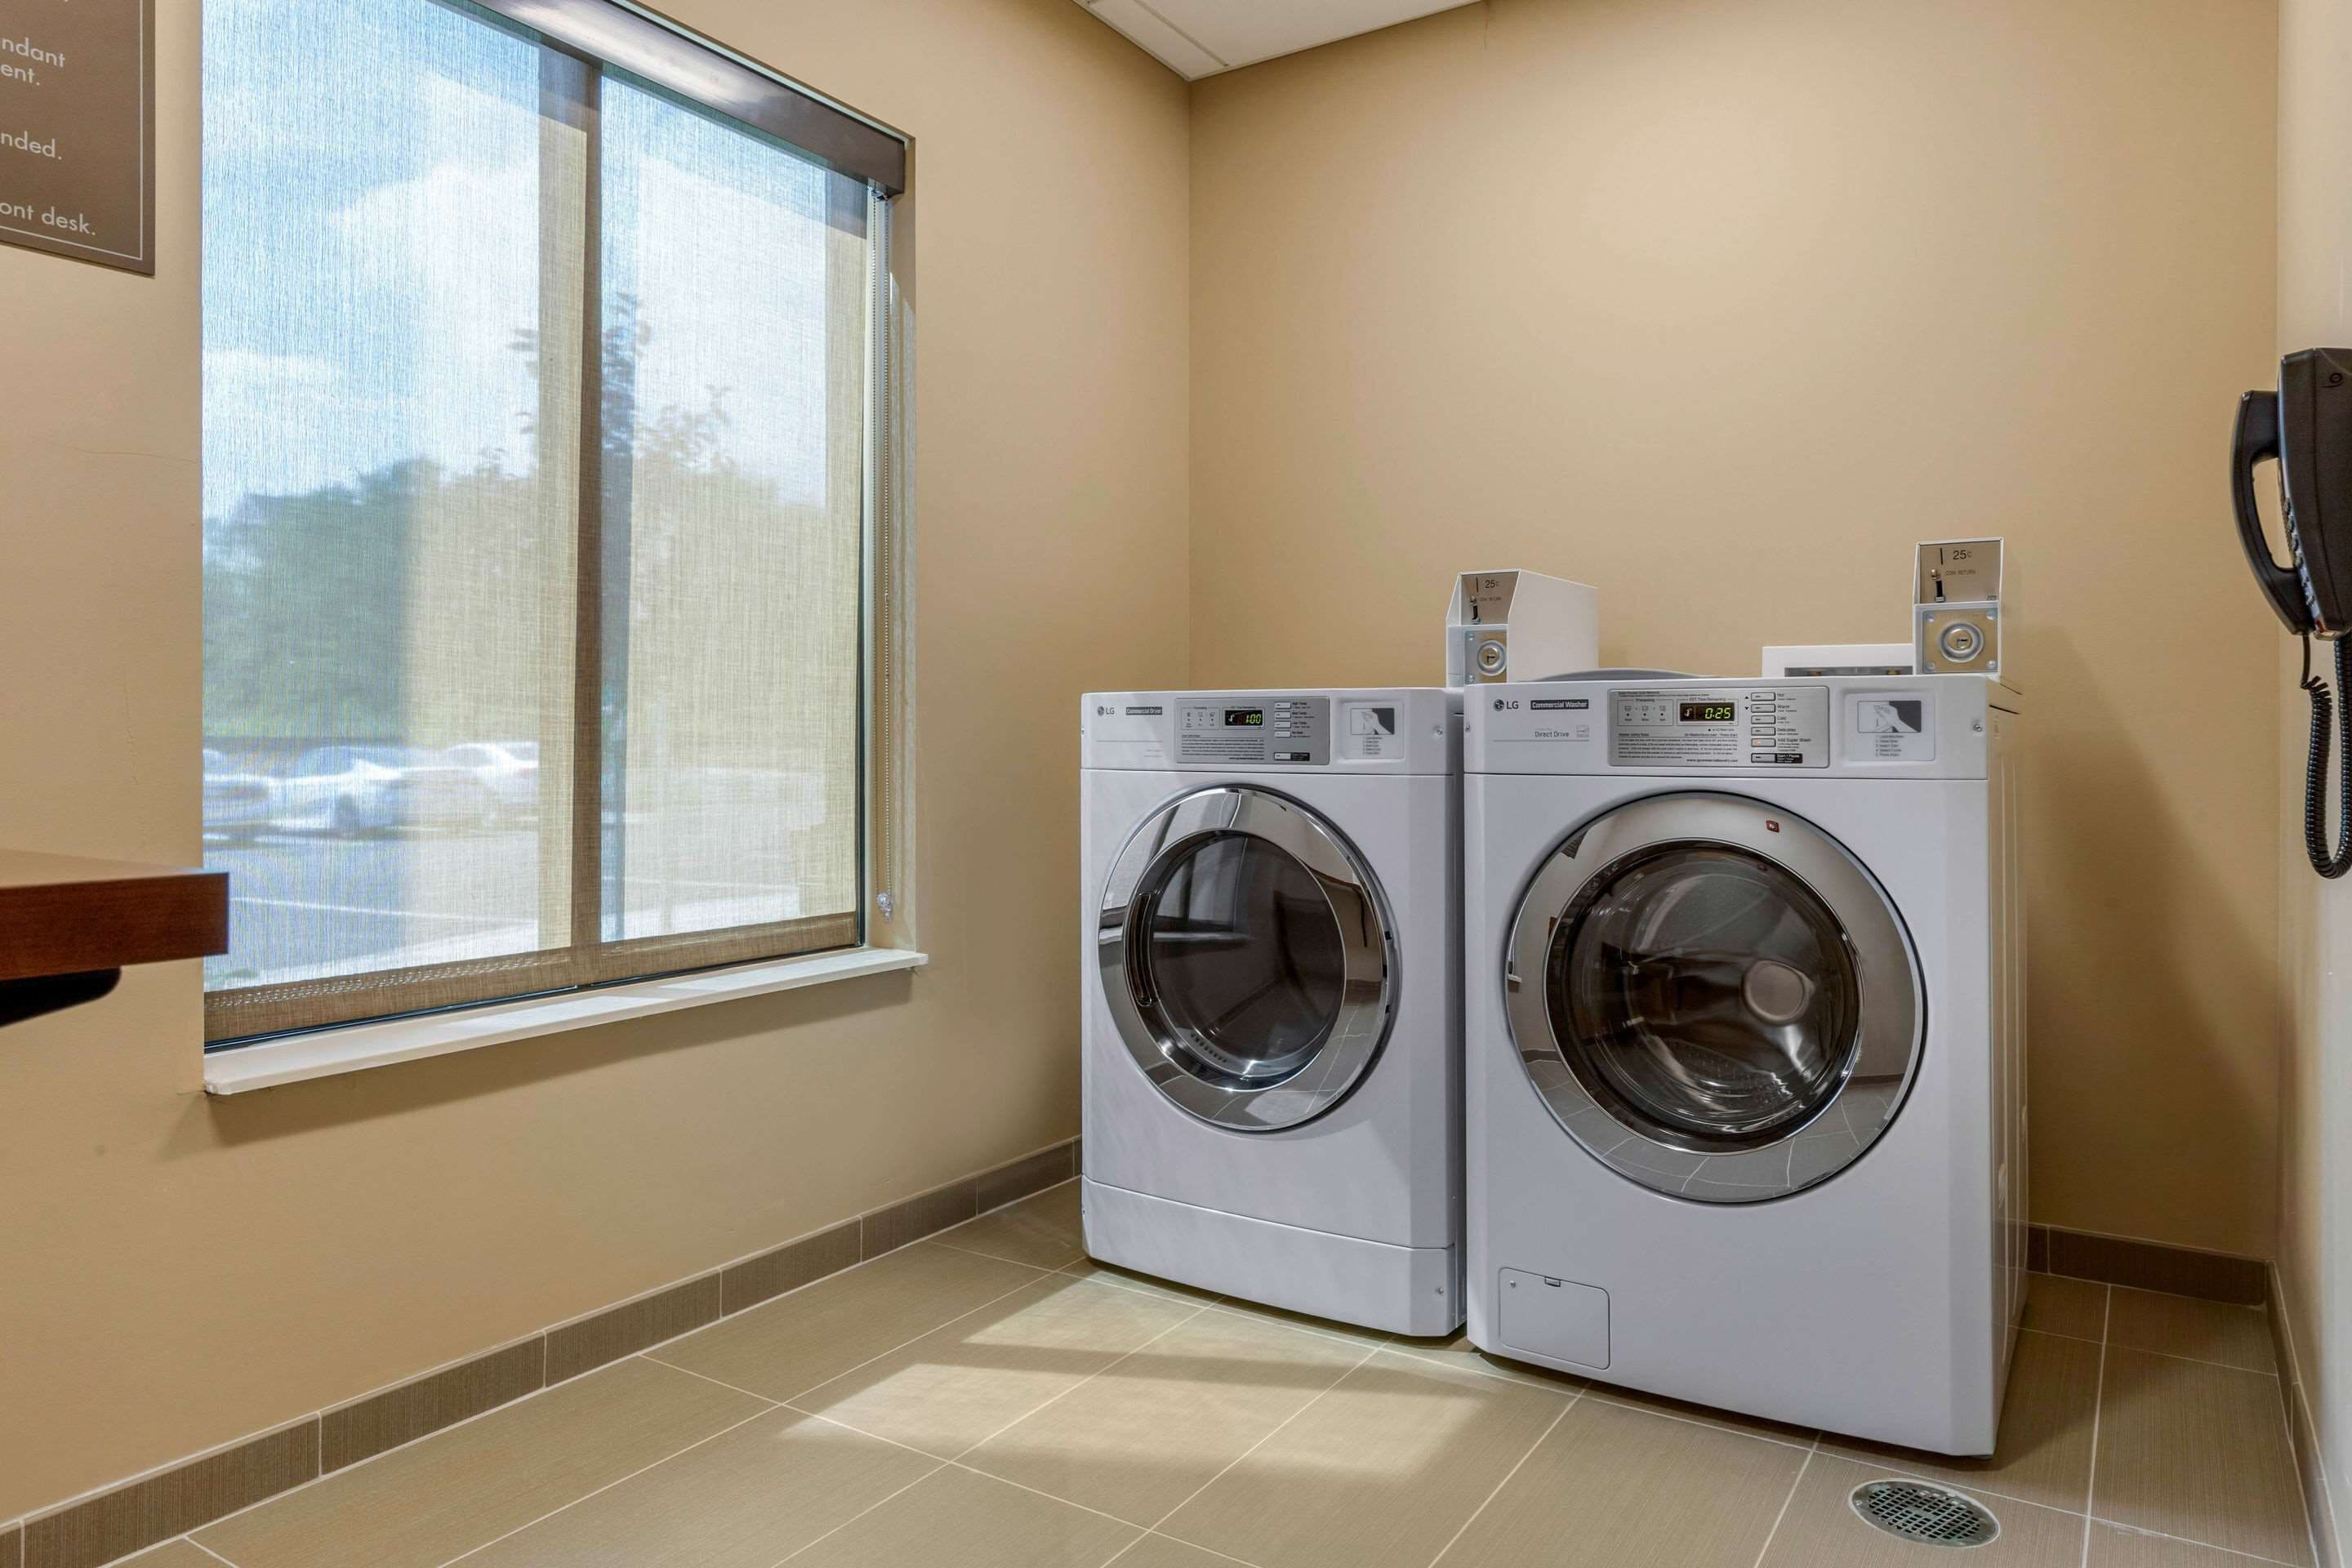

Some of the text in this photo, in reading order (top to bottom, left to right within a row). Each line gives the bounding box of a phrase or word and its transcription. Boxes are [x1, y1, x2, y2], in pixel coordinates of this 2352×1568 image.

[0, 37, 66, 69] ndant
[0, 63, 41, 87] ent.
[0, 130, 63, 160] nded.
[41, 206, 96, 236] desk.
[1105, 706, 1116, 715] LG
[1506, 701, 1519, 710] LG
[1565, 700, 1588, 708] Washer
